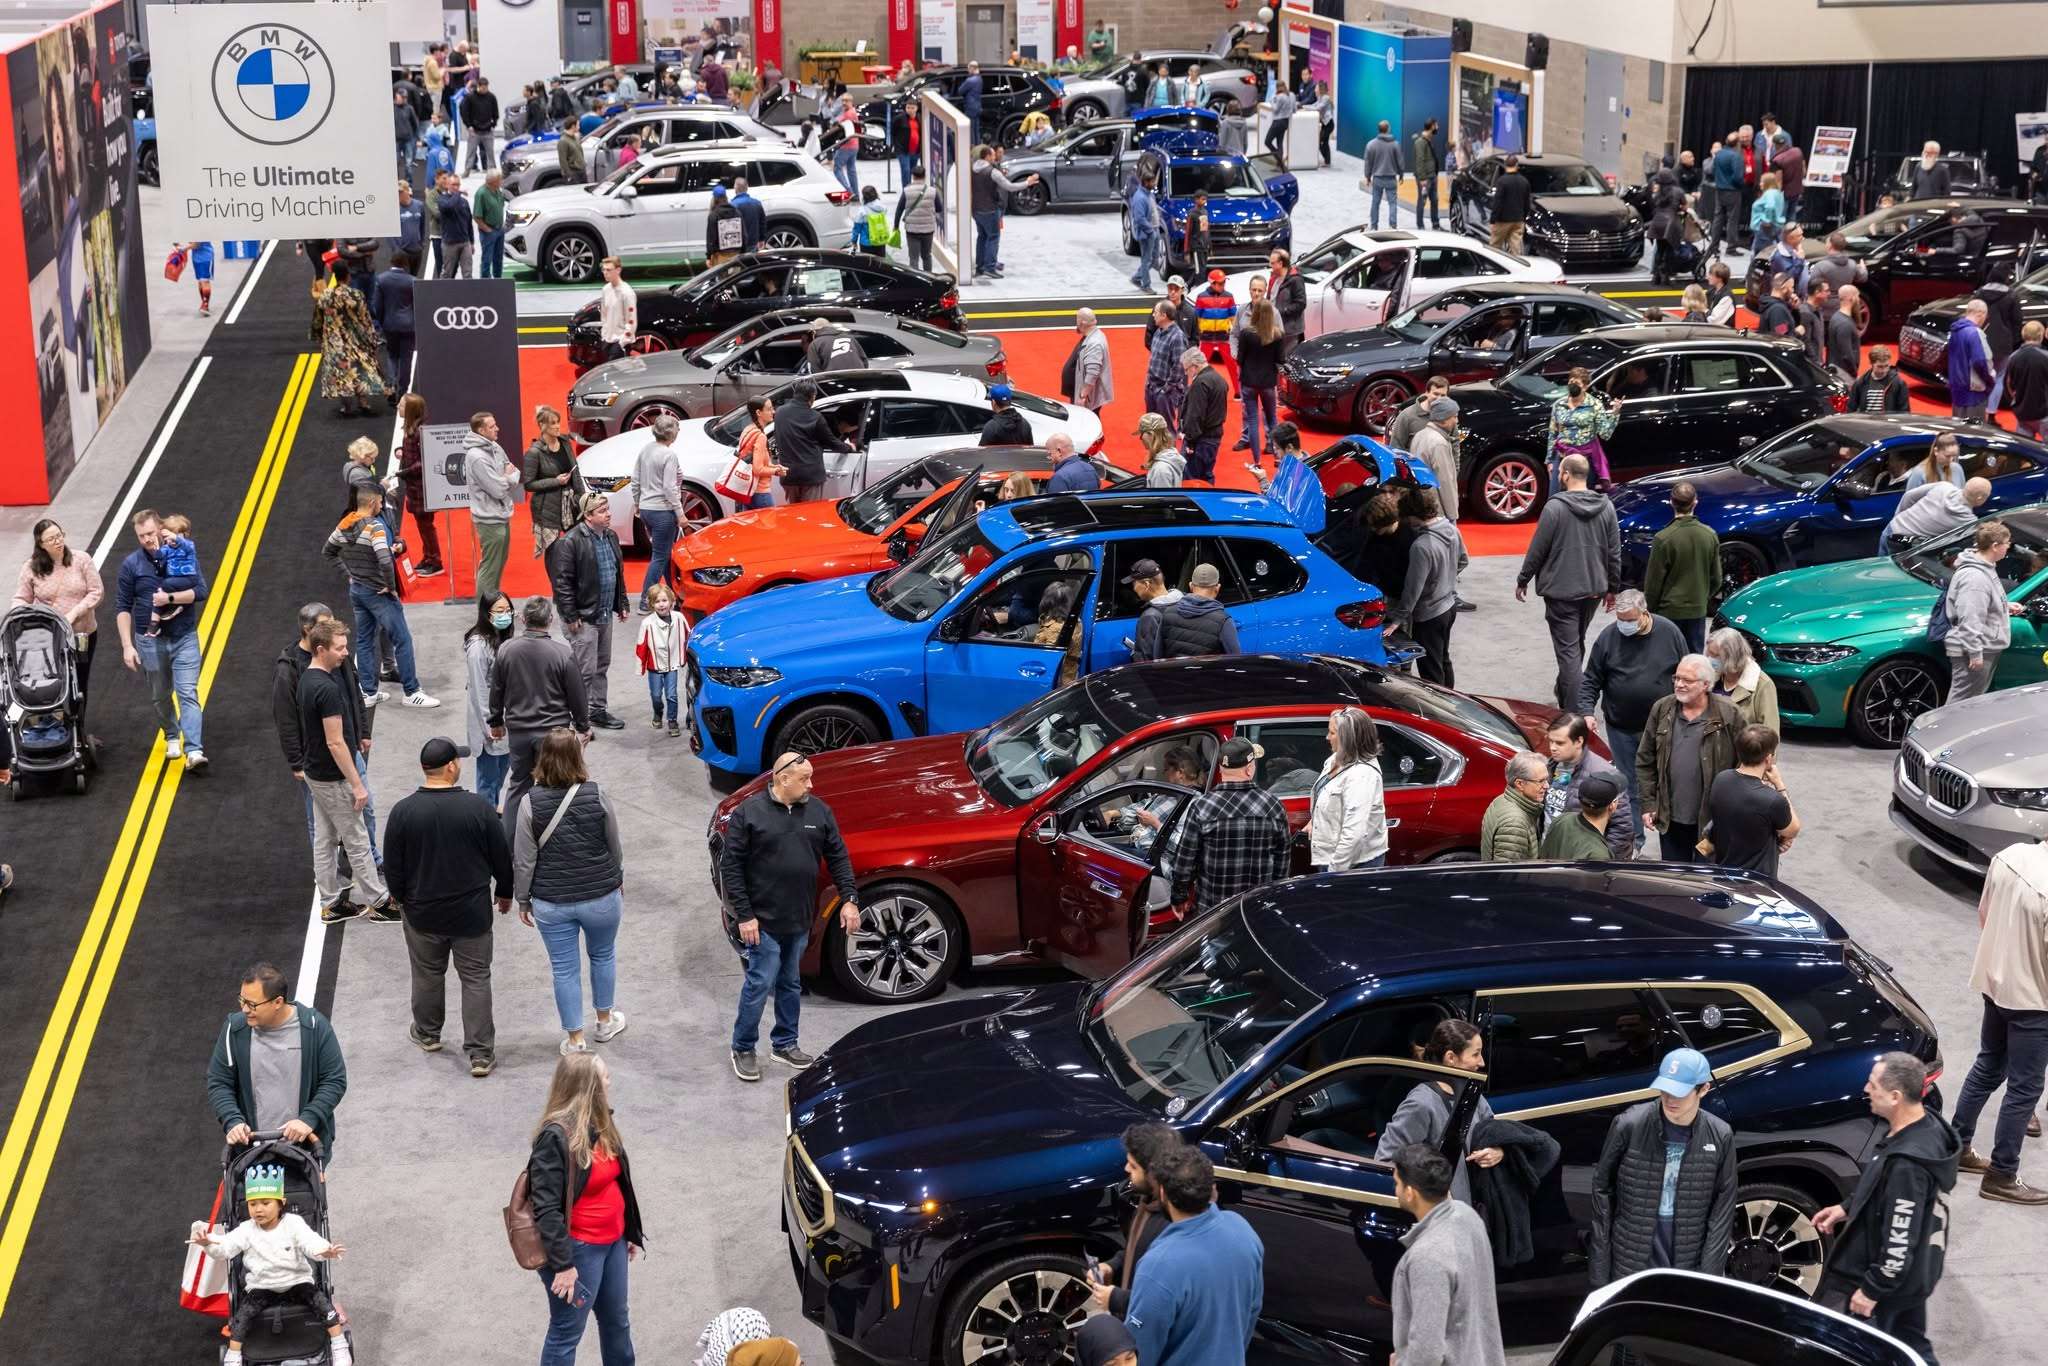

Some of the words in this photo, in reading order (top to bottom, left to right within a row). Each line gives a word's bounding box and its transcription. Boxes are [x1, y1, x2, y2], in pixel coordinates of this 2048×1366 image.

[226, 29, 317, 64] BMW
[202, 167, 246, 188] The
[253, 166, 355, 187] Ultimate
[186, 197, 264, 223] Driving
[444, 494, 452, 502] A
